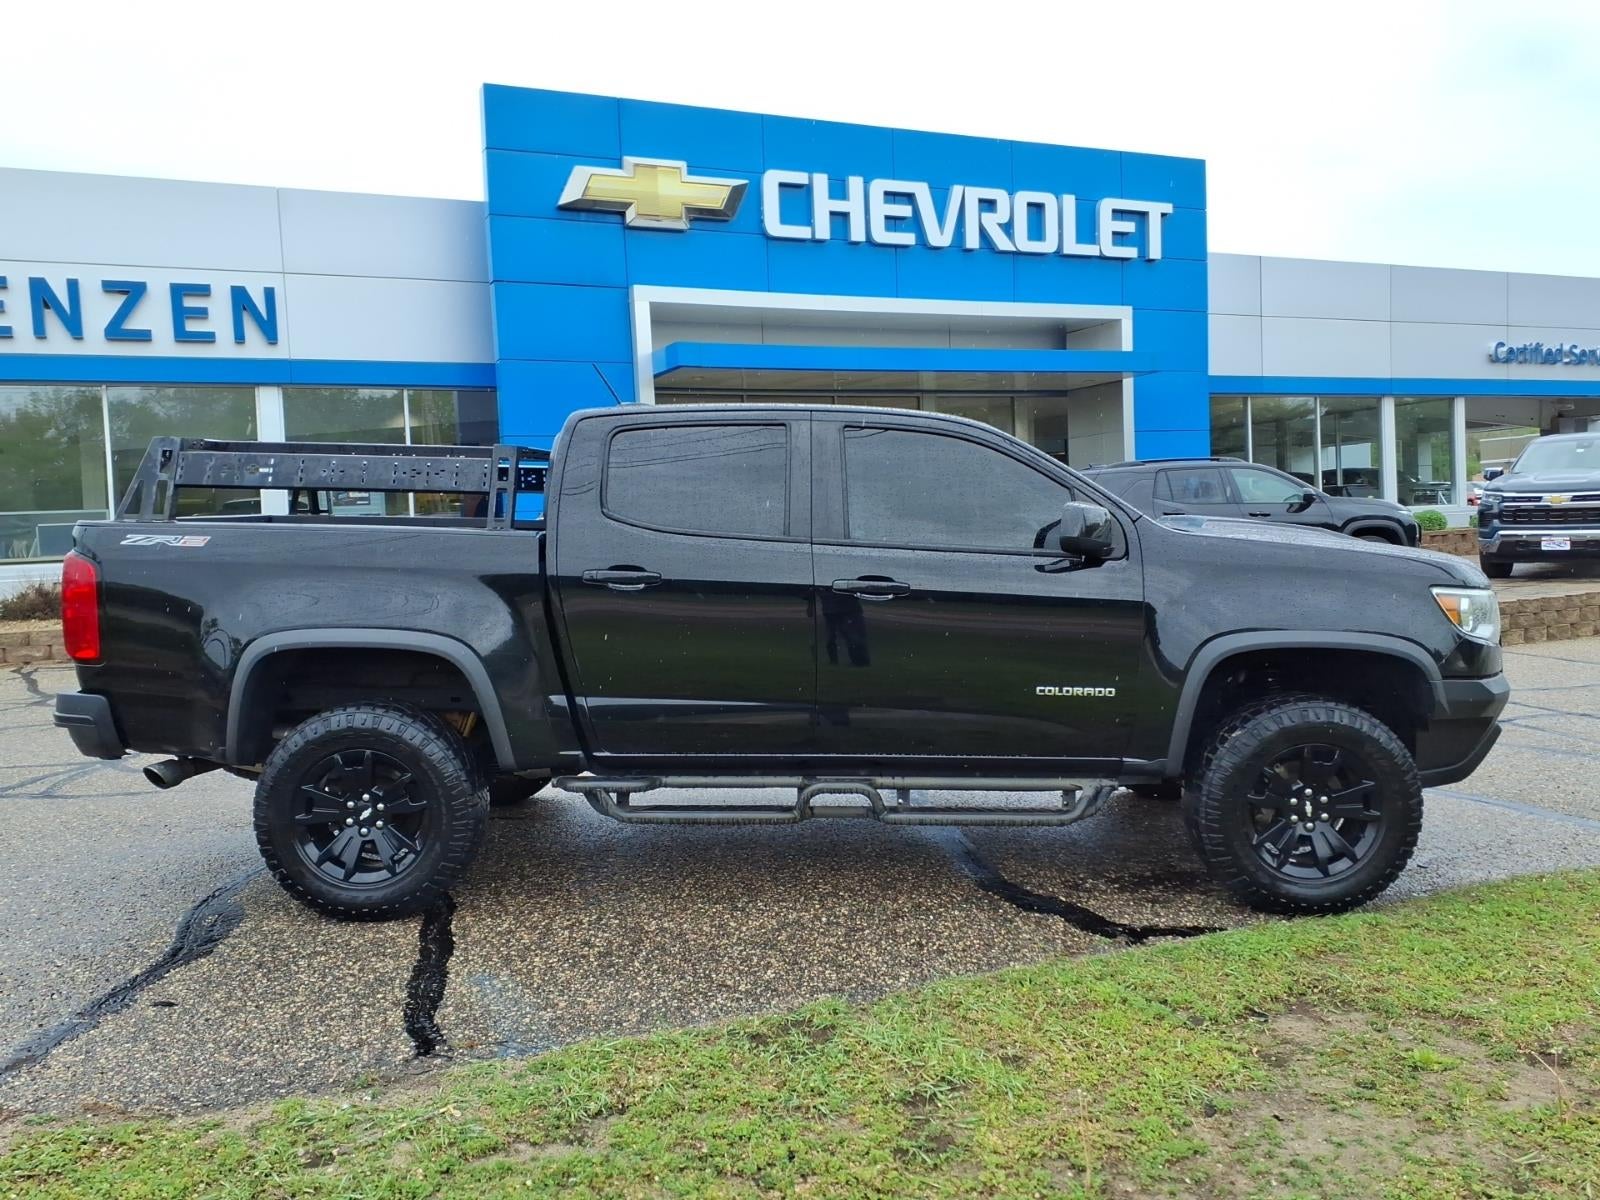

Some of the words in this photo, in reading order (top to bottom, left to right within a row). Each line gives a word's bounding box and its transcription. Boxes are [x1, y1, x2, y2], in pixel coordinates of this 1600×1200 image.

[762, 169, 1173, 260] CHEVROLET
[1493, 341, 1563, 364] Certified
[120, 534, 212, 547] ZR2
[1035, 686, 1116, 697] COLORADO
